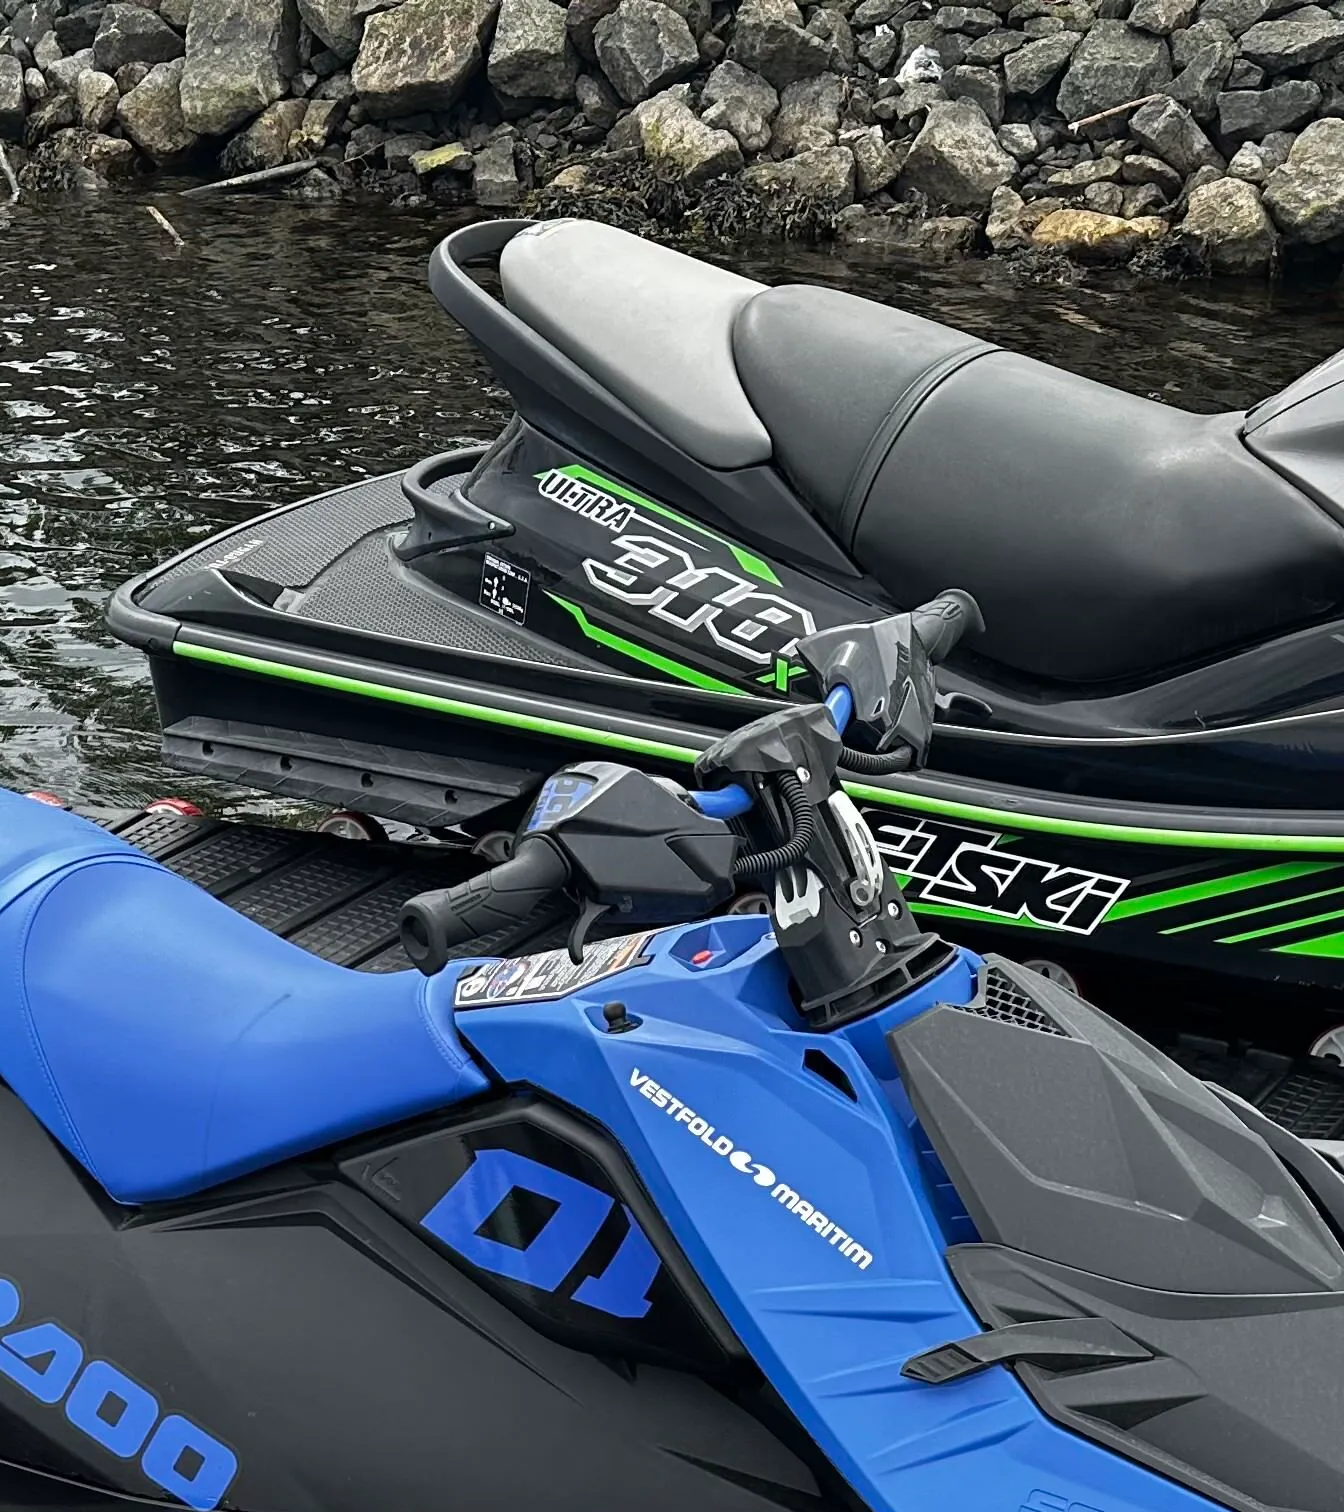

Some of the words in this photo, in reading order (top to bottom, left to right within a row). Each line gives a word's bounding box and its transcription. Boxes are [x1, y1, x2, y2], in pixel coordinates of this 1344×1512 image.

[538, 468, 635, 533] ULTRA
[582, 535, 817, 664] 310
[627, 1067, 735, 1157] VESTFOLD
[770, 1182, 874, 1271] MARITIM
